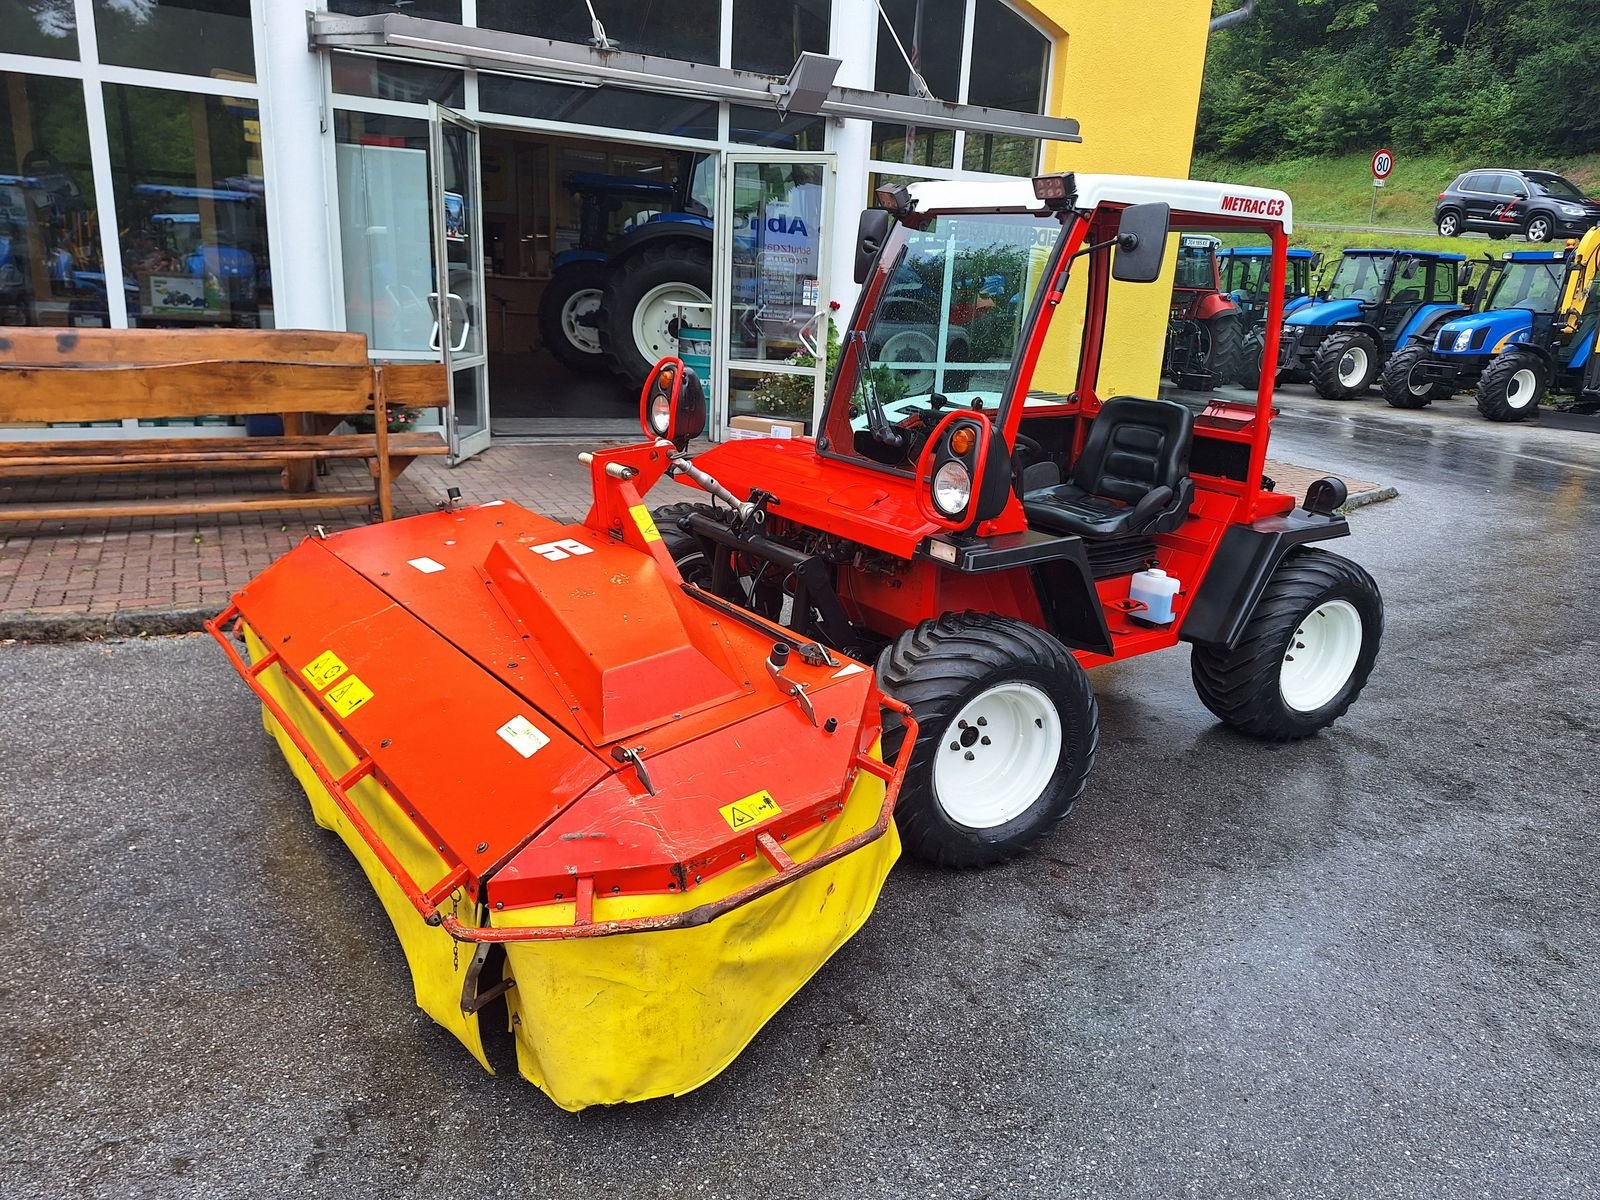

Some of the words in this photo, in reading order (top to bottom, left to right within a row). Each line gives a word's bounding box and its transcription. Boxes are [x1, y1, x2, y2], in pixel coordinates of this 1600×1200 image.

[1376, 156, 1389, 172] 80
[1221, 196, 1266, 214] METRAC
[1266, 199, 1285, 216] G3
